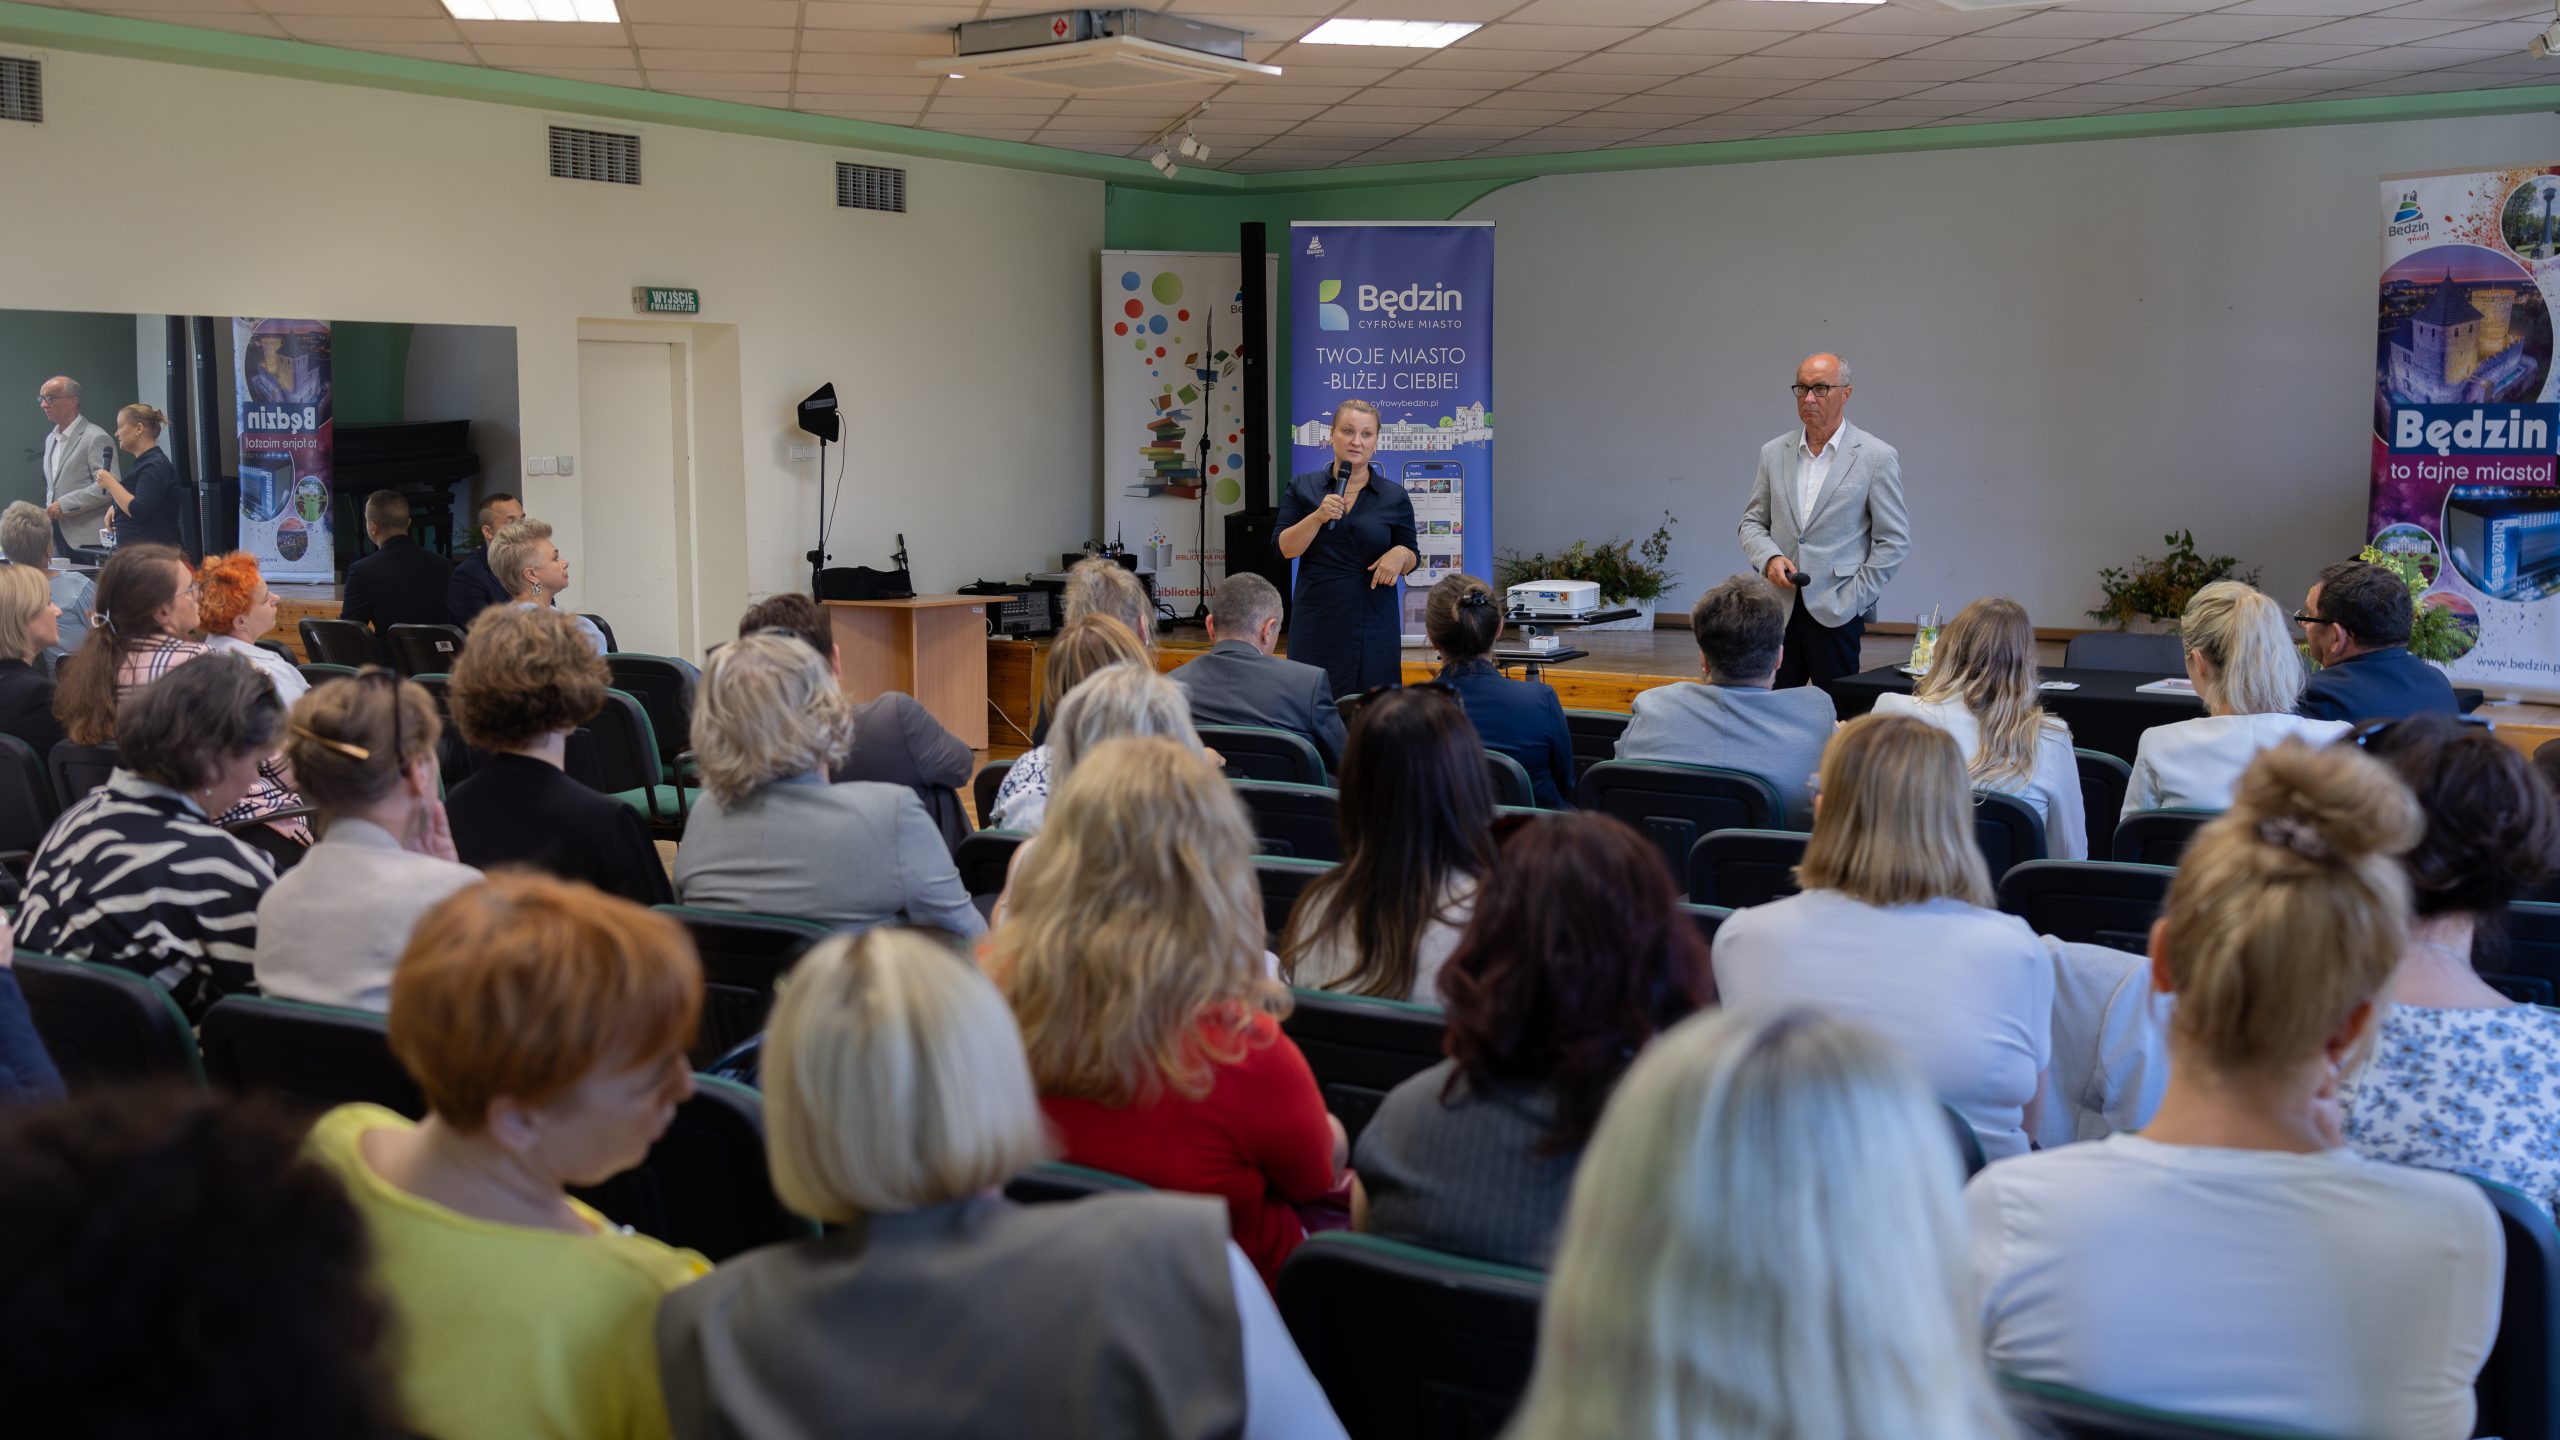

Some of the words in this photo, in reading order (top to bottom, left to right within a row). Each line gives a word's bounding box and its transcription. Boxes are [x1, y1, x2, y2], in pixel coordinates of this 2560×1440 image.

[2388, 222, 2429, 237] Będzin
[652, 290, 695, 304] WYJŚCIE
[1358, 282, 1463, 319] Będzin
[650, 303, 697, 312] EWAKUACYJNE
[1358, 320, 1414, 329] CYFROWE
[1418, 320, 1462, 329] MIASTO
[1316, 348, 1384, 365] TWOJE
[1390, 348, 1466, 365] MIASTO
[1323, 369, 1386, 390] -BLIŻEJ
[1393, 372, 1459, 390] CIEBIE!
[2395, 409, 2548, 457] Będzin
[2390, 463, 2411, 479] to
[2417, 461, 2470, 484] fajne
[2475, 462, 2552, 482] miasto!
